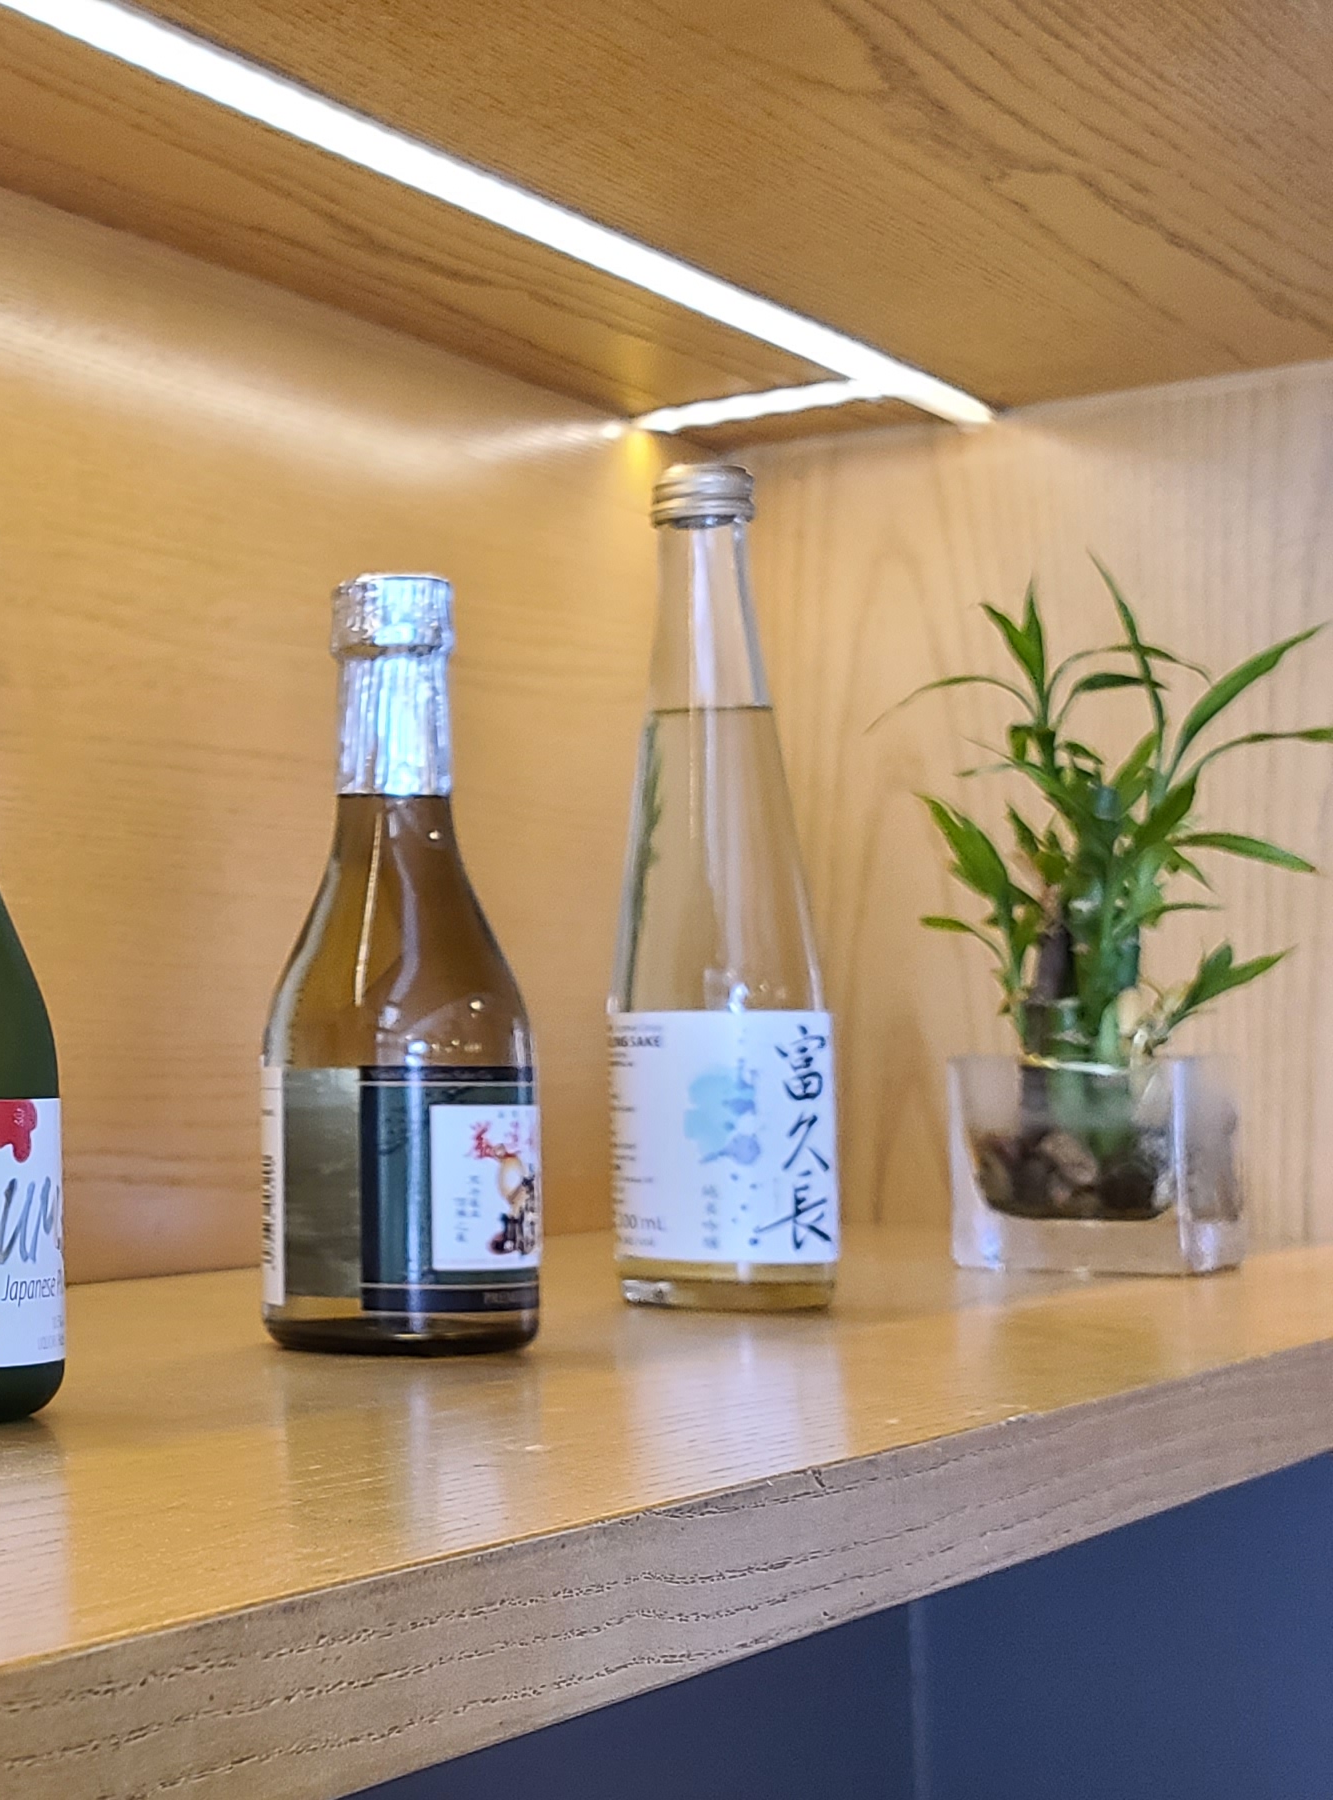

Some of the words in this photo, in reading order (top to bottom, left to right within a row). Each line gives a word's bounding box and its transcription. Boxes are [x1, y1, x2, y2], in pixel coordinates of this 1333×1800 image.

[751, 1023, 833, 1251] 富久長
[0, 1274, 56, 1308] Japanese
